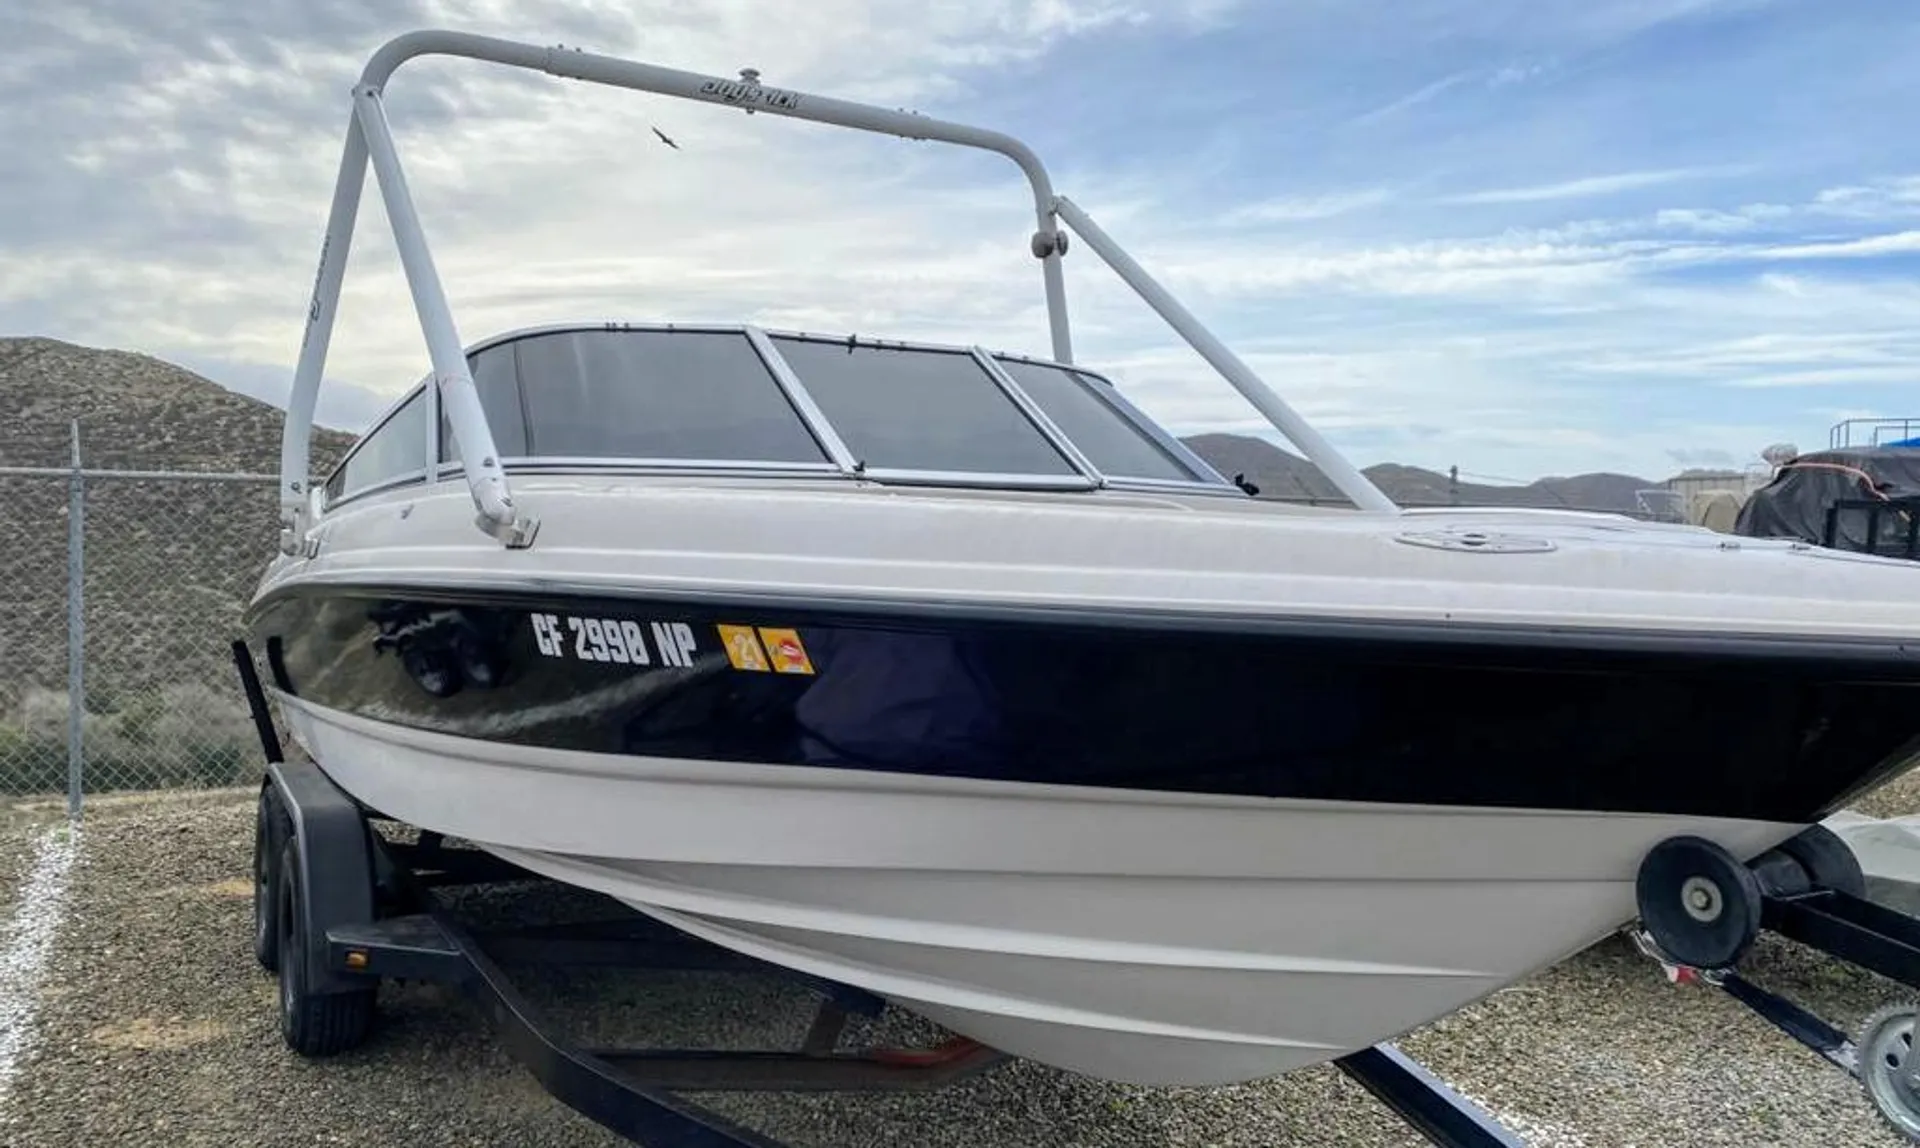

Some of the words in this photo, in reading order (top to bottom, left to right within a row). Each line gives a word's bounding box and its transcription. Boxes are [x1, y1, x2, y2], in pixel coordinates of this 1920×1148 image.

[530, 612, 565, 658] CF
[567, 616, 651, 665] 2990
[650, 621, 698, 668] NP
